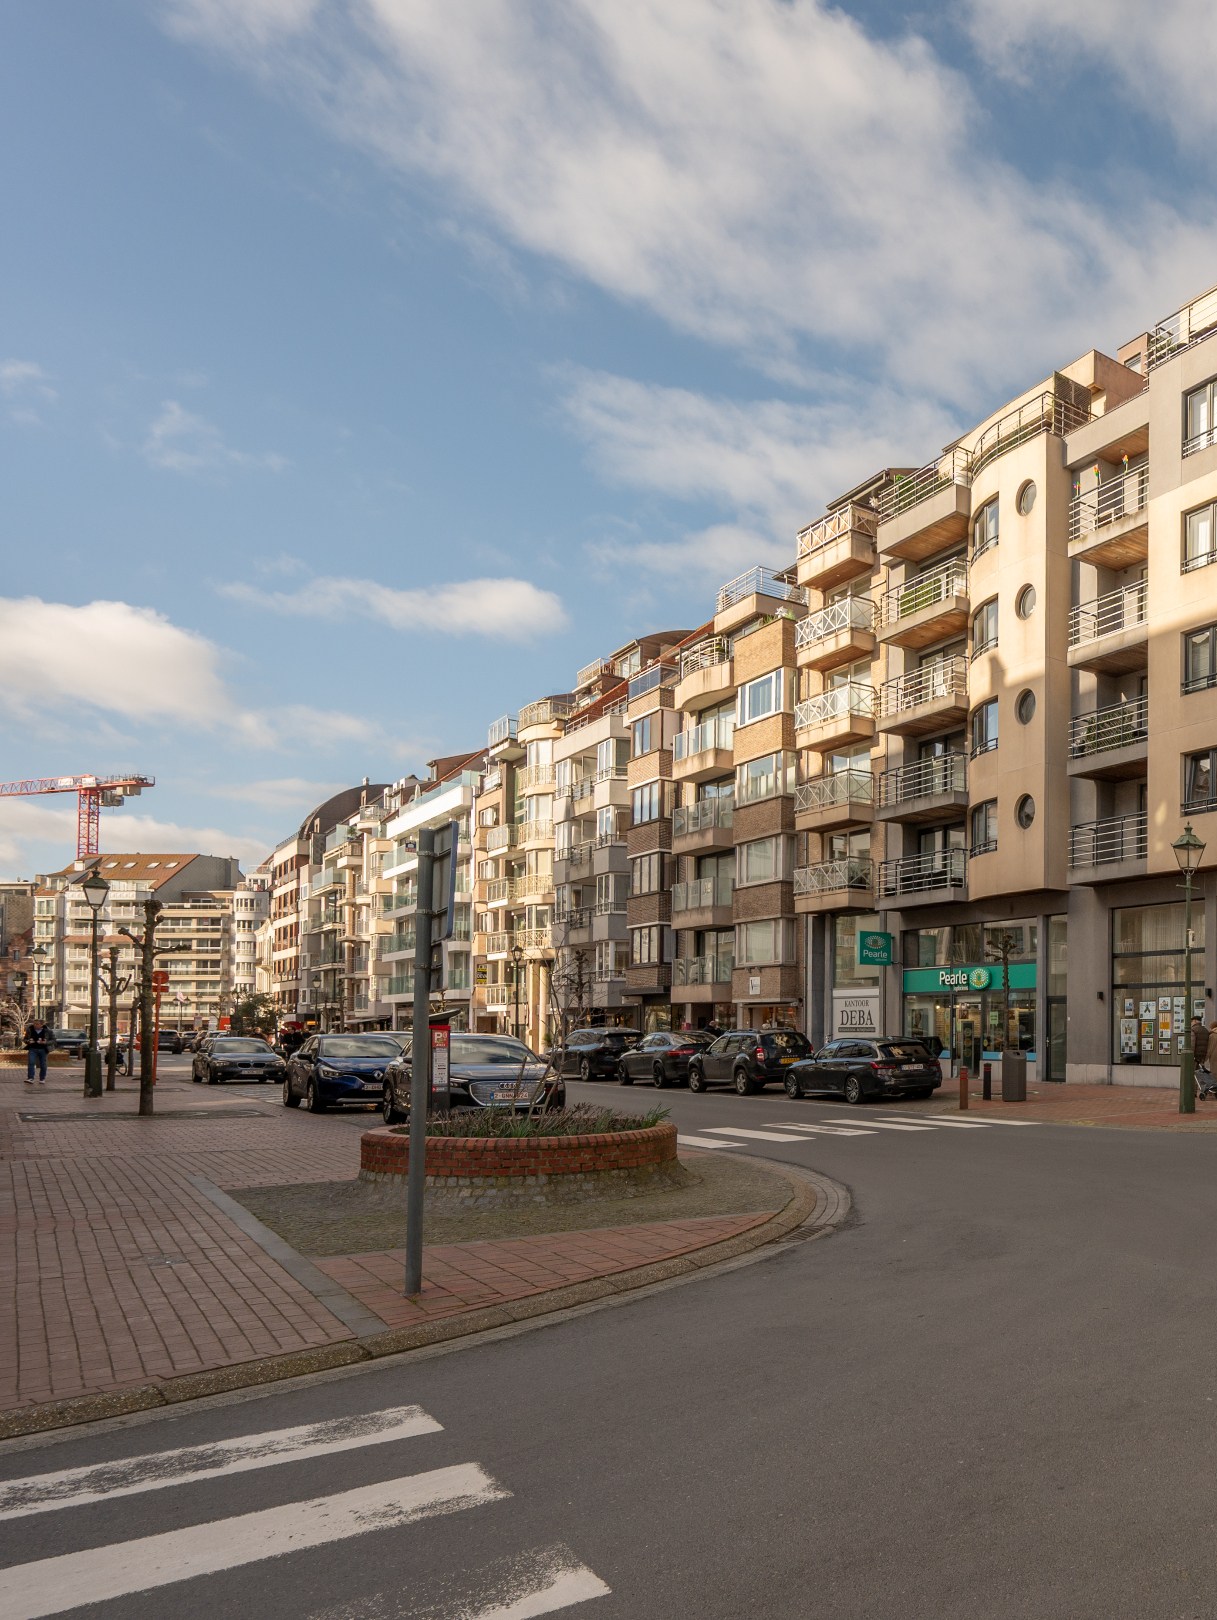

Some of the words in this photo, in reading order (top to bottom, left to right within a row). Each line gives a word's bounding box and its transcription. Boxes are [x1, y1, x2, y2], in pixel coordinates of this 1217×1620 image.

[863, 949, 888, 958] Pearle
[939, 970, 967, 985] Pearle
[844, 999, 869, 1008] KANTOOR
[840, 1009, 874, 1026] DEBA
